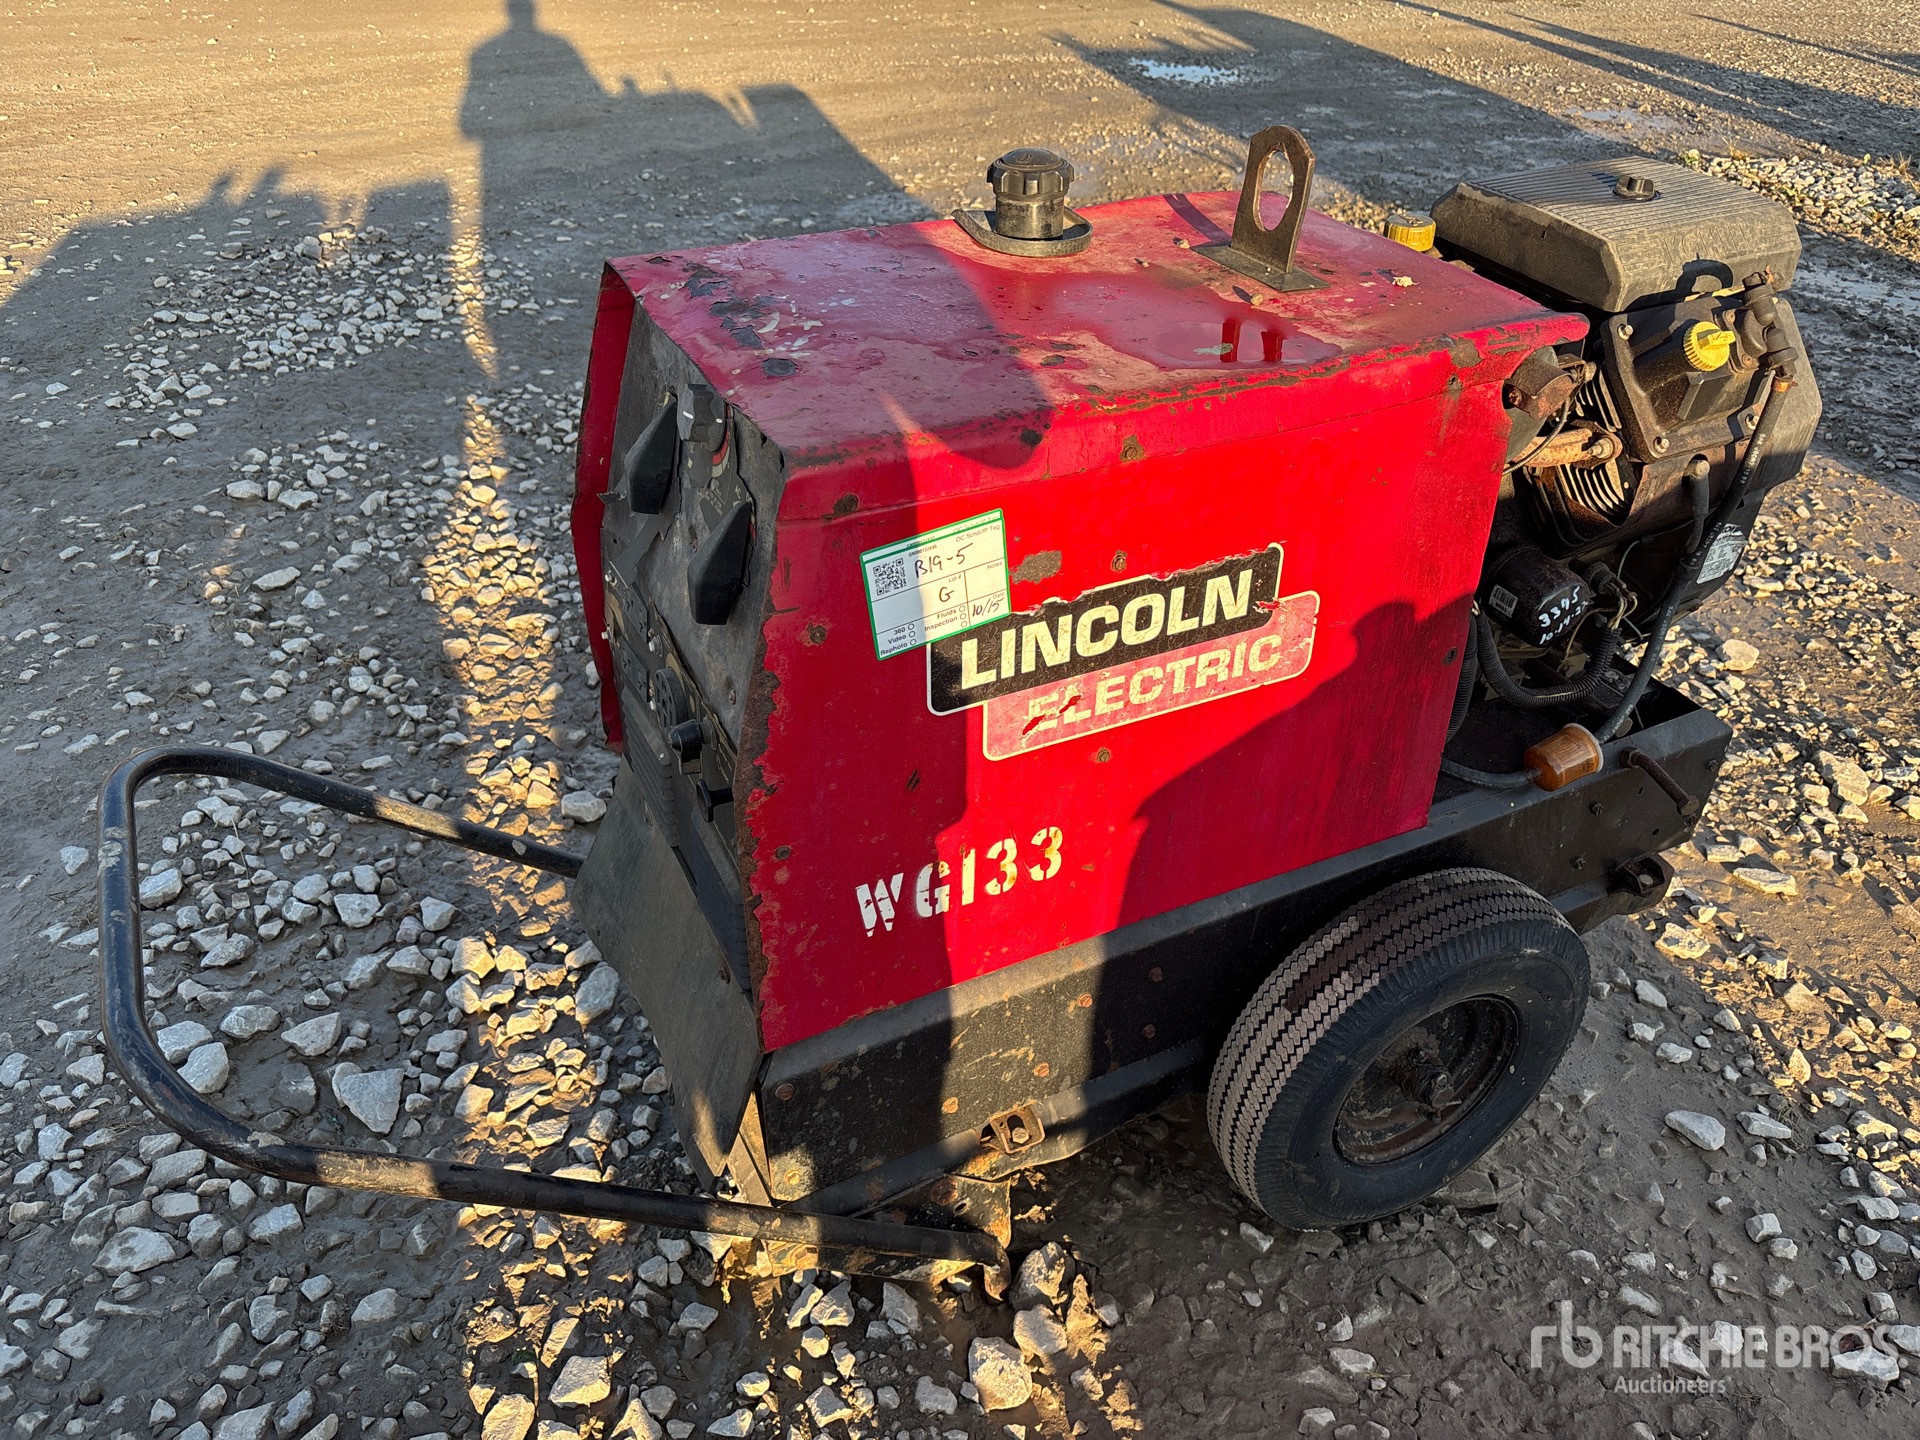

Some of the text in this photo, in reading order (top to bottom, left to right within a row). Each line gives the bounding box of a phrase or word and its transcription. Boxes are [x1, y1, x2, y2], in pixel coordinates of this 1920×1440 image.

[987, 561, 1003, 570] Notes
[938, 586, 955, 603] G
[992, 591, 1005, 600] Date
[936, 609, 957, 619] Fluids
[972, 596, 1005, 617] 10/15
[893, 627, 906, 635] 360
[924, 616, 958, 632] Inspection
[961, 569, 1254, 690] LINCOLN
[888, 635, 907, 645] Video
[880, 643, 908, 657] Rephoto
[1022, 634, 1283, 732] ELECTRIC
[855, 826, 1064, 938] WG133
